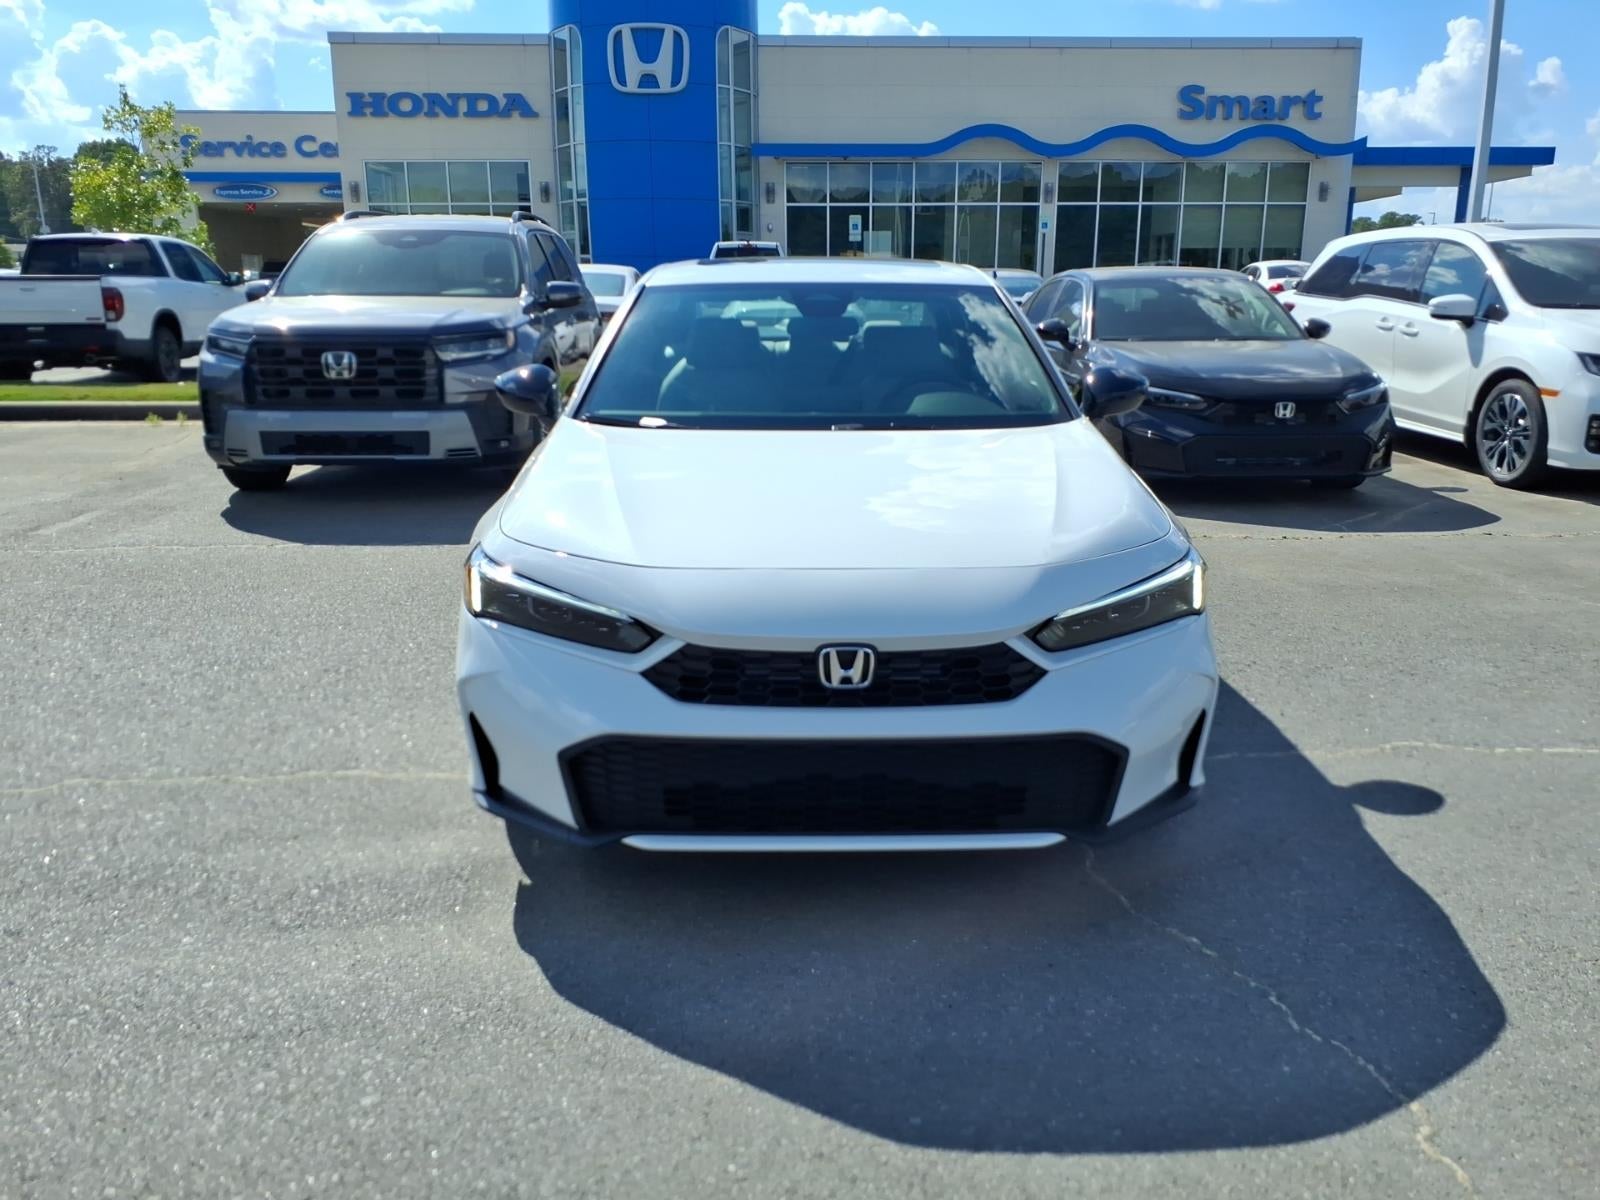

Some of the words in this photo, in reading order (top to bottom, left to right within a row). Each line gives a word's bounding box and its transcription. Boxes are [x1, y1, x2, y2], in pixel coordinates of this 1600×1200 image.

[346, 92, 539, 118] HONDA
[1177, 84, 1323, 121] Smart
[180, 134, 287, 158] Service
[294, 134, 339, 158] Ce
